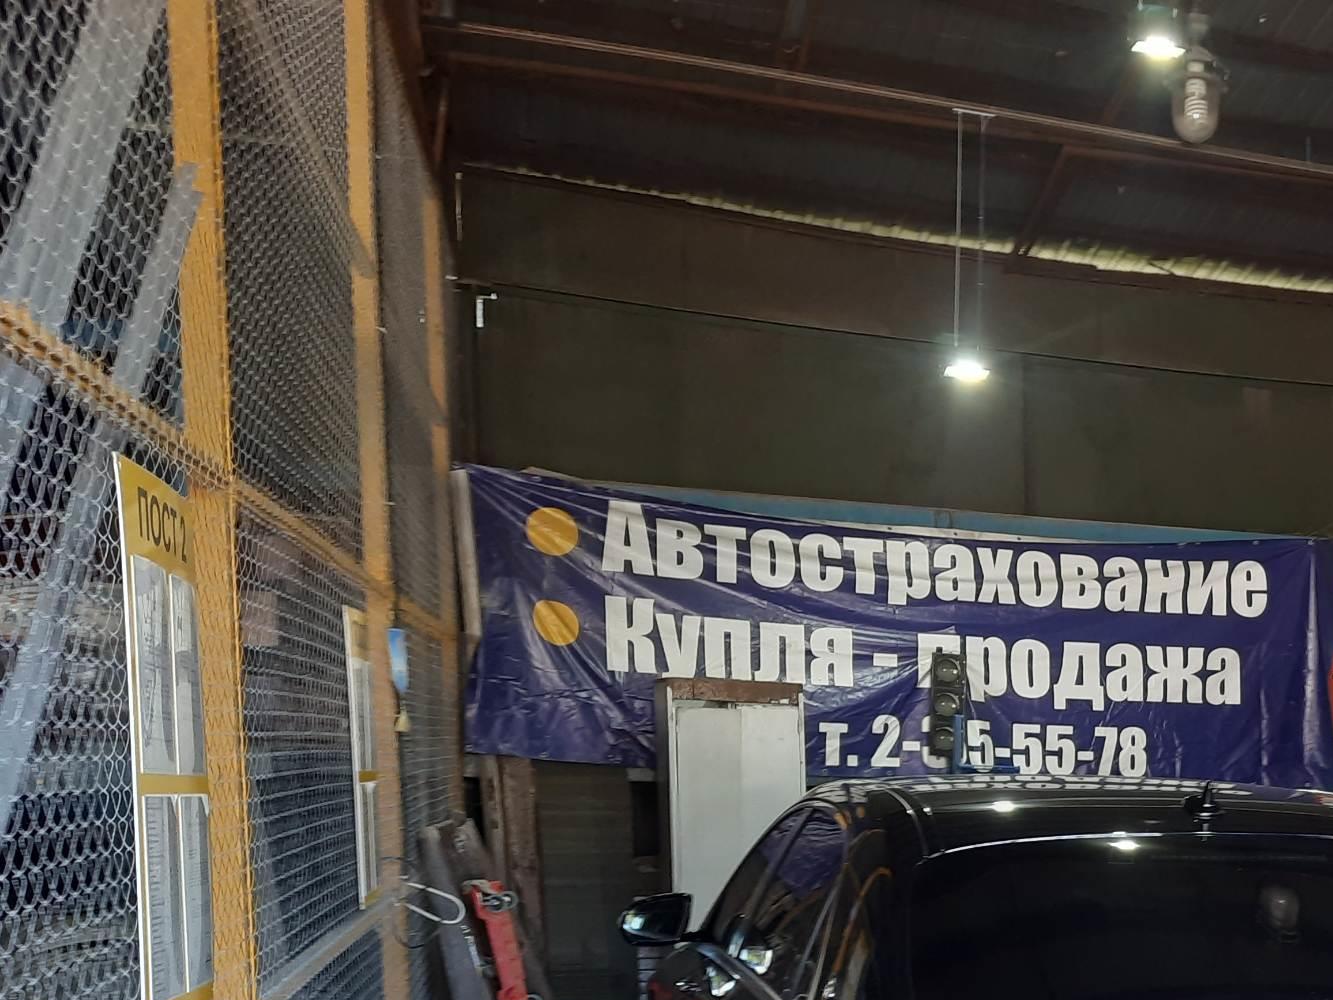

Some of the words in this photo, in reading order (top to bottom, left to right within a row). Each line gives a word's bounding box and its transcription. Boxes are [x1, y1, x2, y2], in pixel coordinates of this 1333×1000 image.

[137, 486, 177, 557] ПОСТ
[180, 516, 187, 563] 2
[602, 500, 1268, 618] Автострахование
[605, 595, 854, 687] Купля
[872, 653, 898, 667] -
[818, 722, 858, 767] т.
